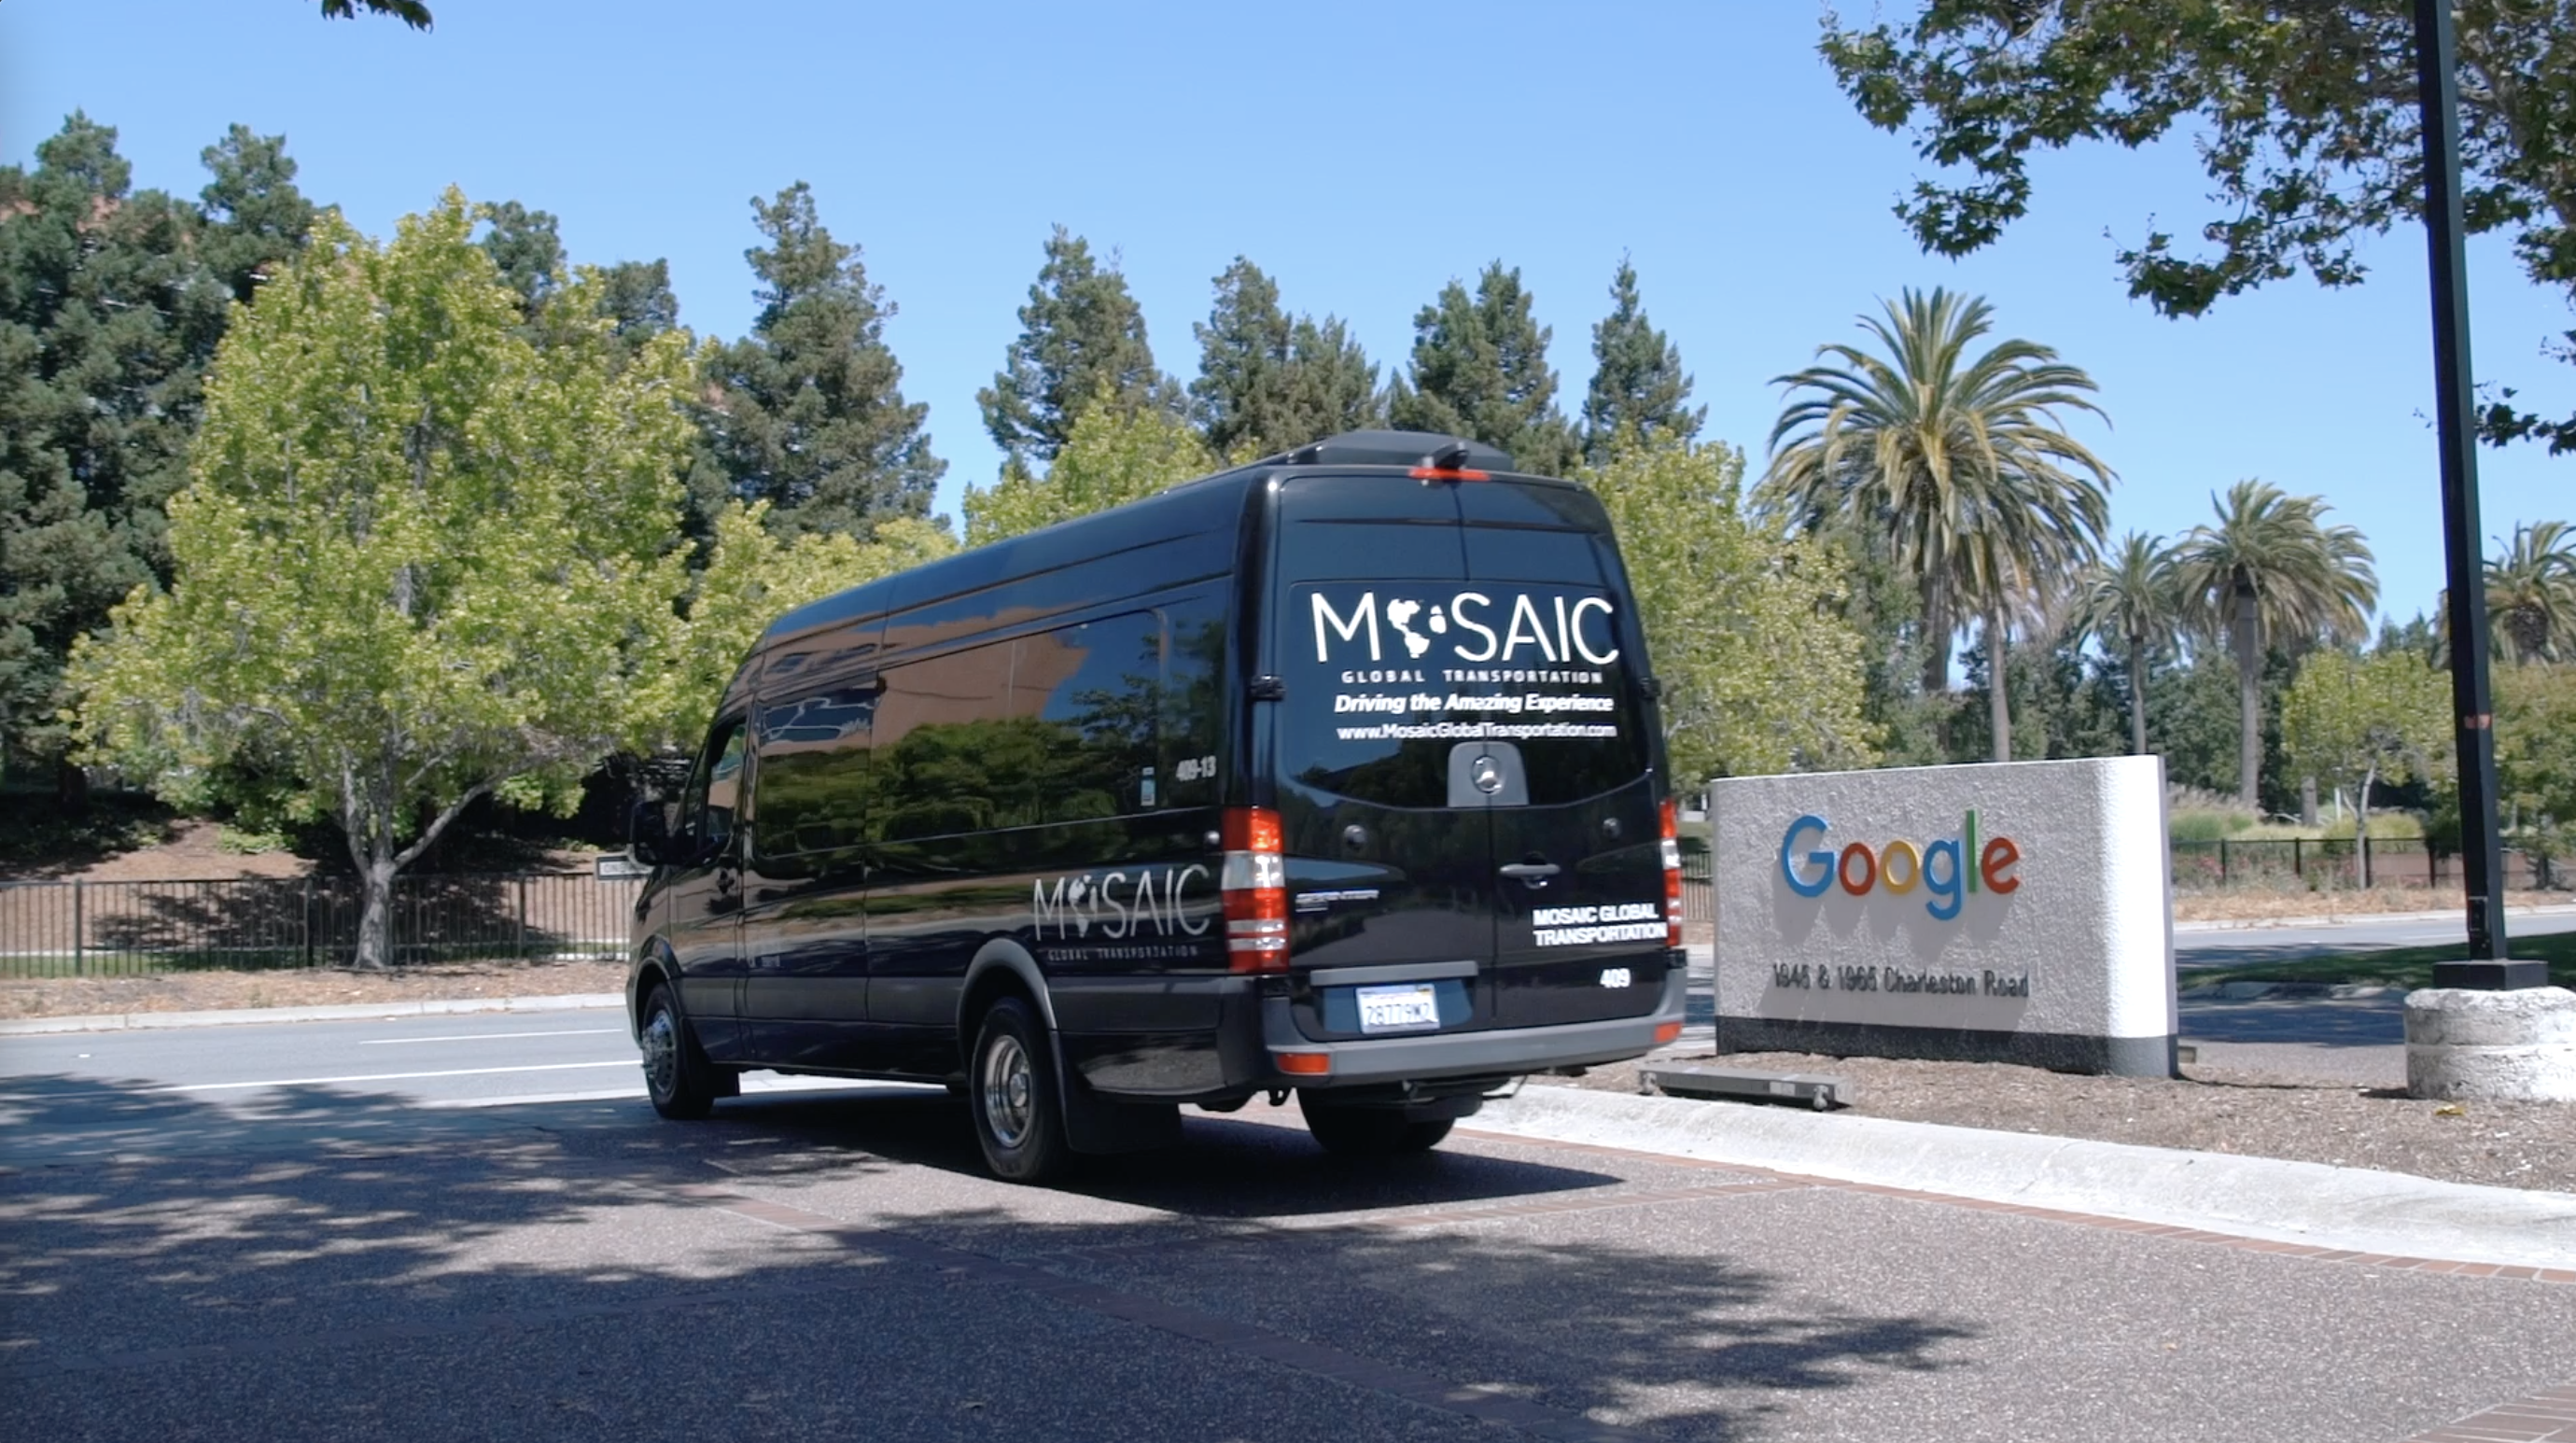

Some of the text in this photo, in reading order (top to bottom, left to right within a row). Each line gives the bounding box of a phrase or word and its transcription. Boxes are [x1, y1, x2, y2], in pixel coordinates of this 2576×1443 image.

[1341, 669, 1603, 684] GLOBAL TRANSPORTATION
[1334, 693, 1615, 714] Driving the Amazing Experience
[1337, 722, 1617, 740] www.MosaicGlobalTransportation.com
[1176, 755, 1217, 782] 409-13
[1780, 805, 2022, 921] Google
[1533, 903, 1659, 926] MOSAIC GLOBAL
[1533, 922, 1668, 946] TRANSPORTATION
[1048, 945, 1198, 962] GLOBAL TRANSPORTATION
[1600, 968, 1631, 988] 409
[1772, 962, 2029, 998] 1945 & 1965 Charleston Road
